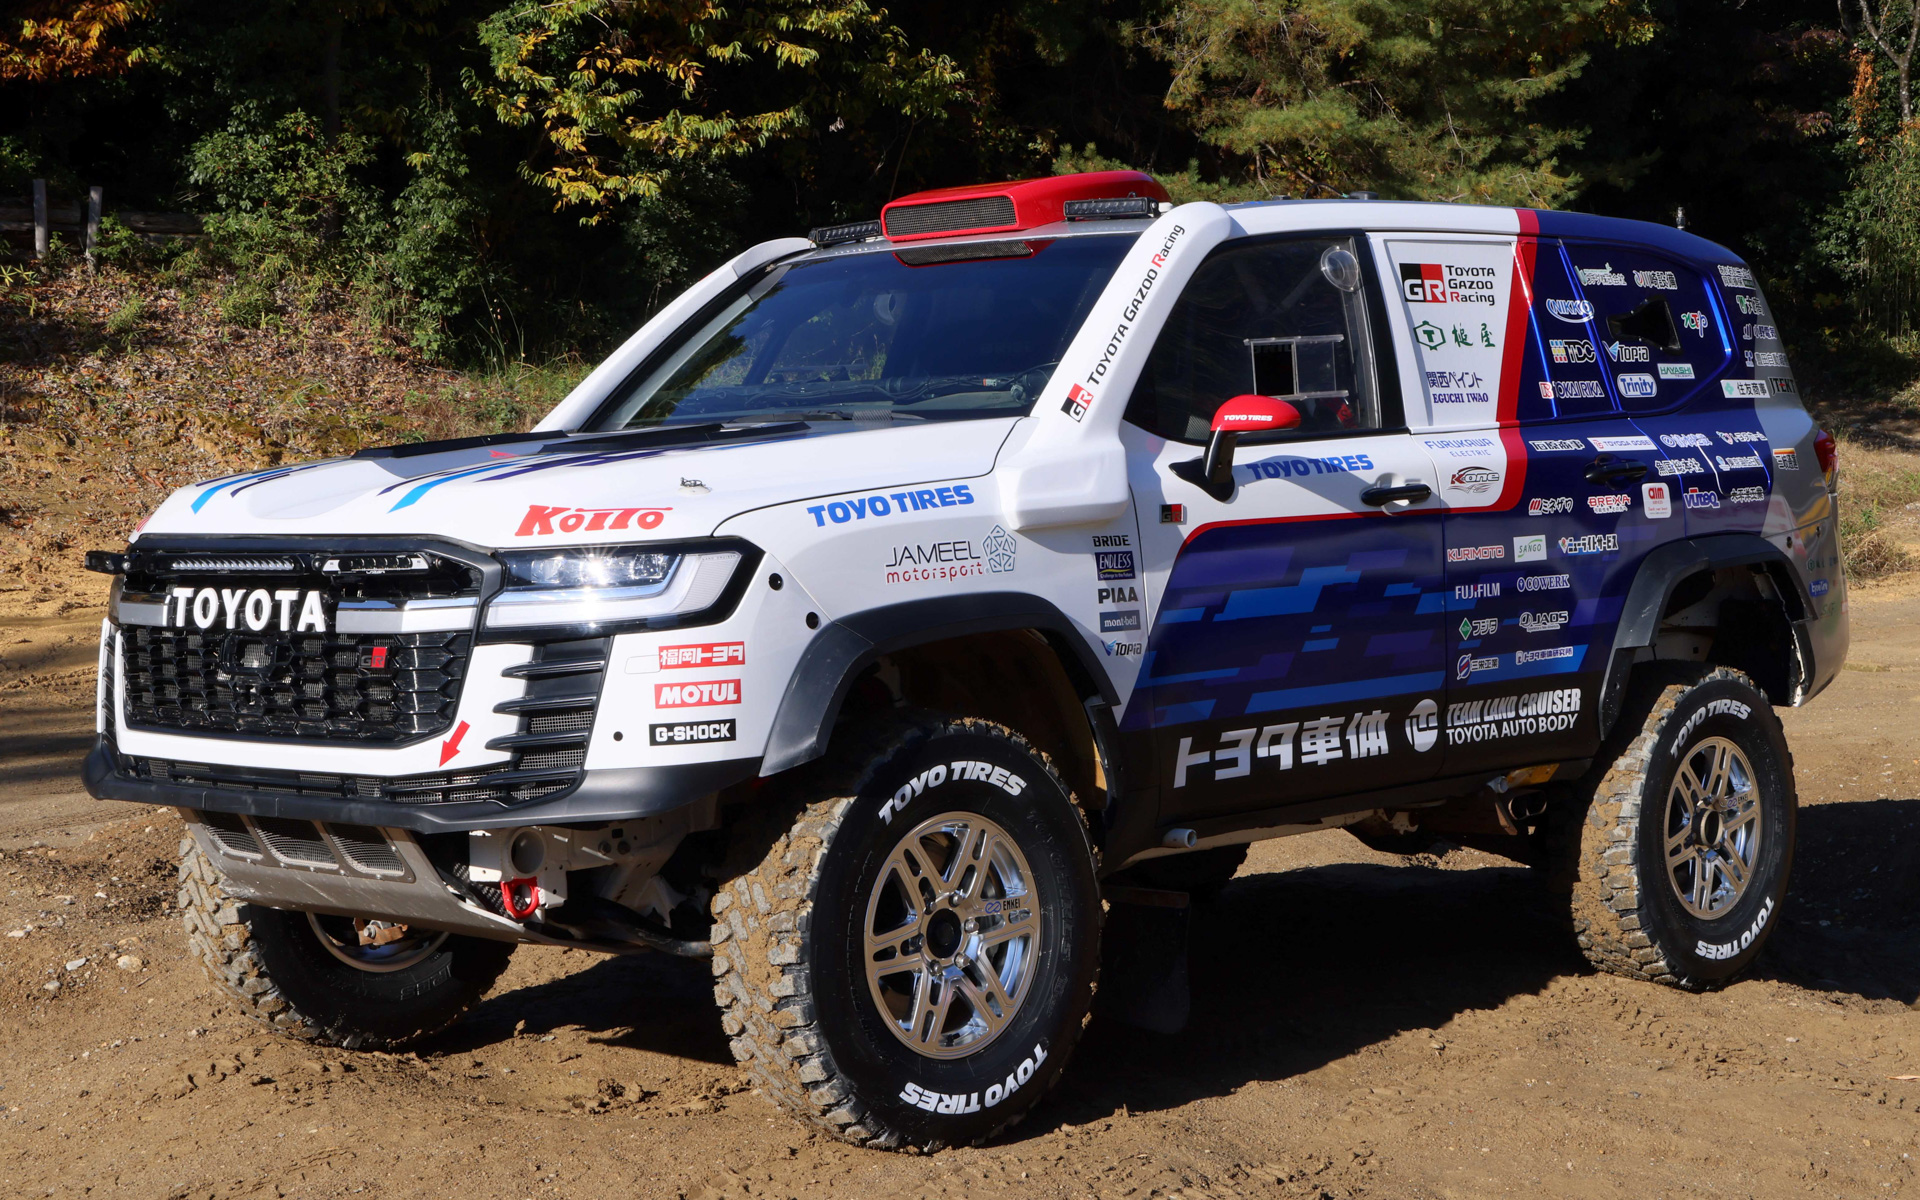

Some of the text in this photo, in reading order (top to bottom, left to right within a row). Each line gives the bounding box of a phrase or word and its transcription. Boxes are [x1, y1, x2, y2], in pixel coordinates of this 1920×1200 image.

[1445, 265, 1496, 277] TOYOTA
[1448, 278, 1494, 290] GAZOO
[1087, 323, 1129, 386] TOYOTA
[1123, 268, 1158, 322] GAZOO
[1152, 224, 1185, 268] Racing
[1450, 292, 1496, 306] Racing
[1550, 300, 1594, 315] NIKKO
[1619, 345, 1650, 362] Topia
[1660, 366, 1692, 375] HAYASHI
[1425, 371, 1483, 389] 関西ペイント
[1620, 376, 1654, 395] Trinity
[1579, 381, 1604, 397] RIKA
[1737, 382, 1767, 396] 住友商事
[1432, 393, 1489, 403] EGUCHI IWAO
[1224, 414, 1273, 422] TOYO TIRES
[1424, 438, 1495, 450] FURUKAWA
[1450, 450, 1492, 458] ELECTRIC
[1246, 454, 1374, 480] TOYO TIRES
[807, 485, 975, 528] TOYO TIRES
[1542, 498, 1573, 514] ミネザワ
[1589, 496, 1631, 507] BREXA
[1092, 535, 1132, 547] BRIDE
[1519, 543, 1542, 553] SANGO
[885, 540, 981, 567] JAMEEL
[1099, 552, 1132, 569] ENDLESS
[1447, 545, 1504, 561] KURIMOTO
[886, 562, 983, 584] motorsport
[1455, 582, 1501, 599] FUJIFILM
[1525, 575, 1570, 591] COWERK
[1098, 587, 1139, 604] PIAA
[172, 587, 328, 633] TOYOTA
[1533, 611, 1569, 625] JAOS
[1473, 618, 1498, 636] フジタ
[659, 645, 744, 665] 福岡トヨタ
[1116, 642, 1142, 656] Topia
[1471, 658, 1499, 671] 三栄工業
[659, 683, 739, 705] MOTUL
[1447, 688, 1581, 727] TEAM LAND CRUISER
[655, 723, 731, 742] G-SHOCK
[1446, 713, 1579, 745] TOYOTA AUTO BODY
[1670, 699, 1752, 759] TOYO TIRES
[1173, 709, 1390, 789] トヨタ車体
[878, 760, 1028, 826] TOYO TIRES
[1694, 896, 1775, 960] TOYO TIRES
[898, 1043, 1048, 1115] TOYO TIRES
